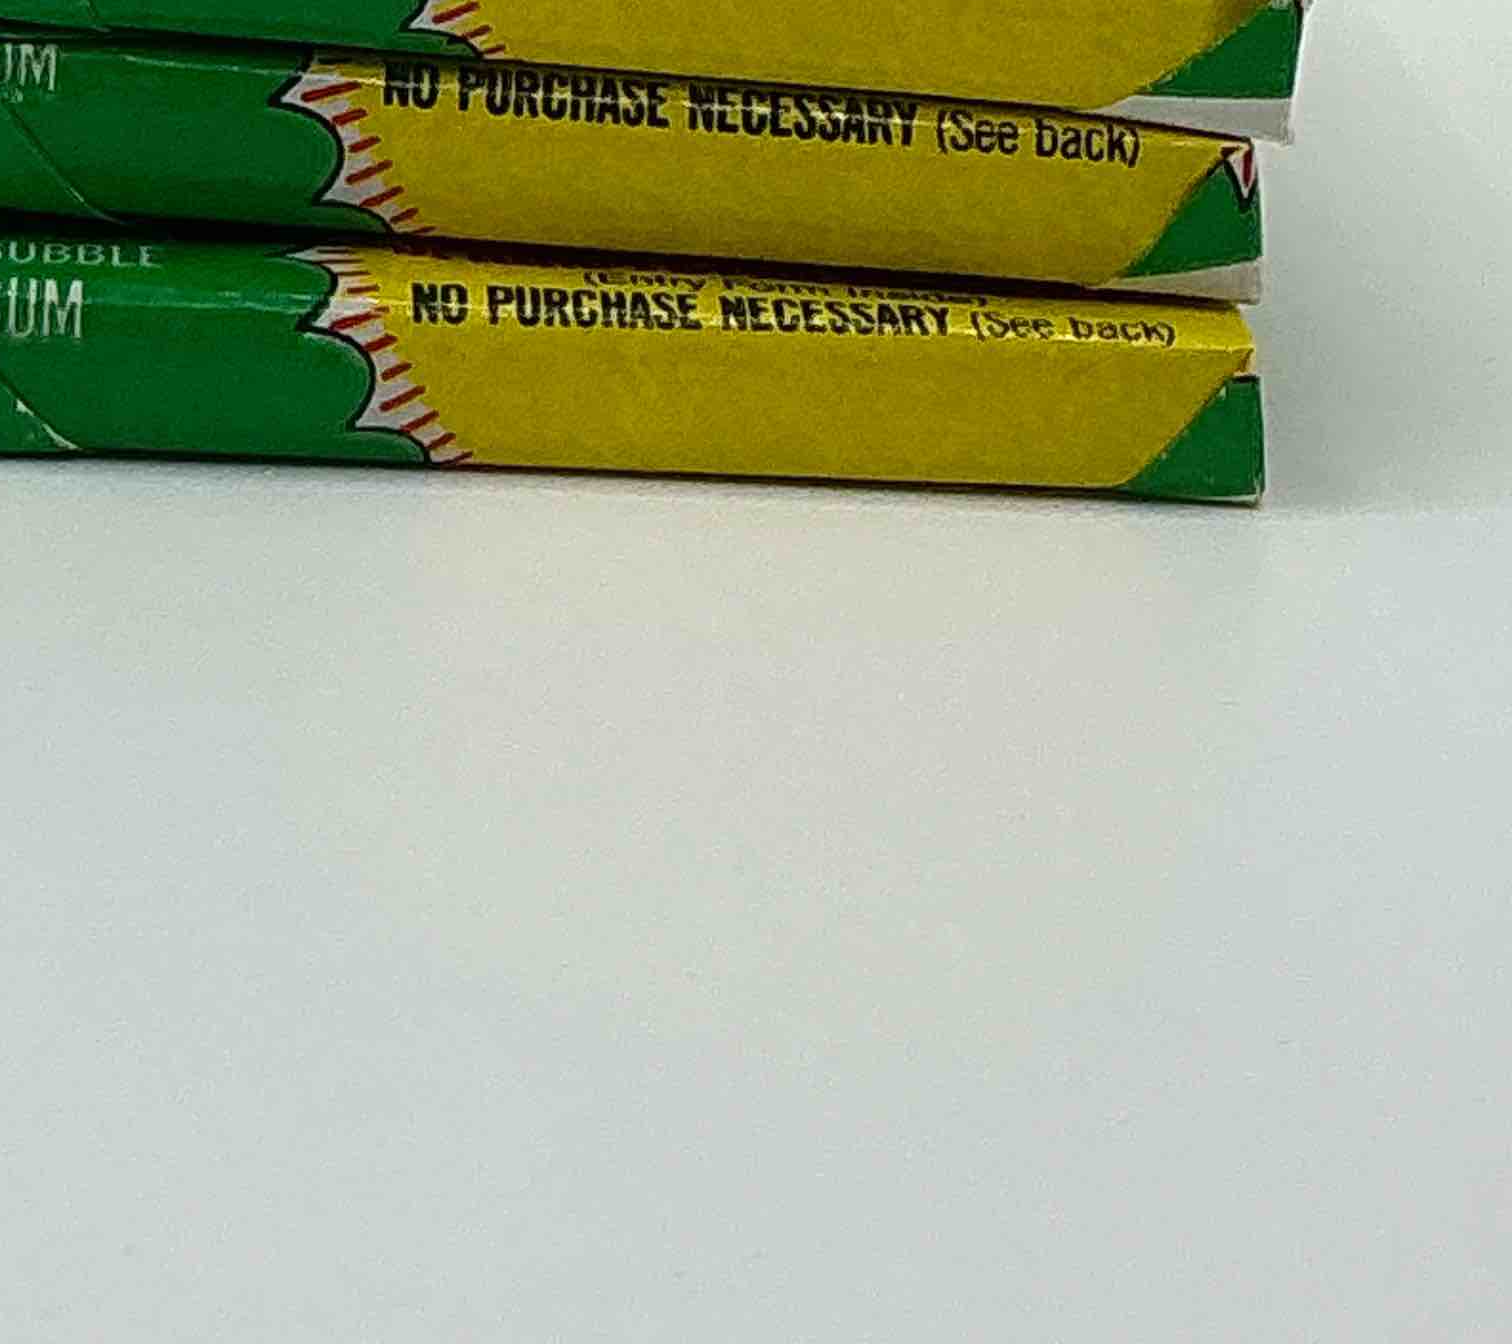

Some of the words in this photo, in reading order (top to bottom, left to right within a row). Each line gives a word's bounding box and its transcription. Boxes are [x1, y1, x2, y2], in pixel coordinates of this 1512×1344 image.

[382, 63, 440, 109] NO
[457, 64, 670, 128] PURCHASE
[688, 78, 919, 146] NECESSARY
[937, 109, 1020, 154] (See
[1035, 118, 1141, 168] back)
[412, 282, 469, 326] NO
[488, 284, 703, 330] PURCHASE
[718, 294, 949, 336] NECESSARY
